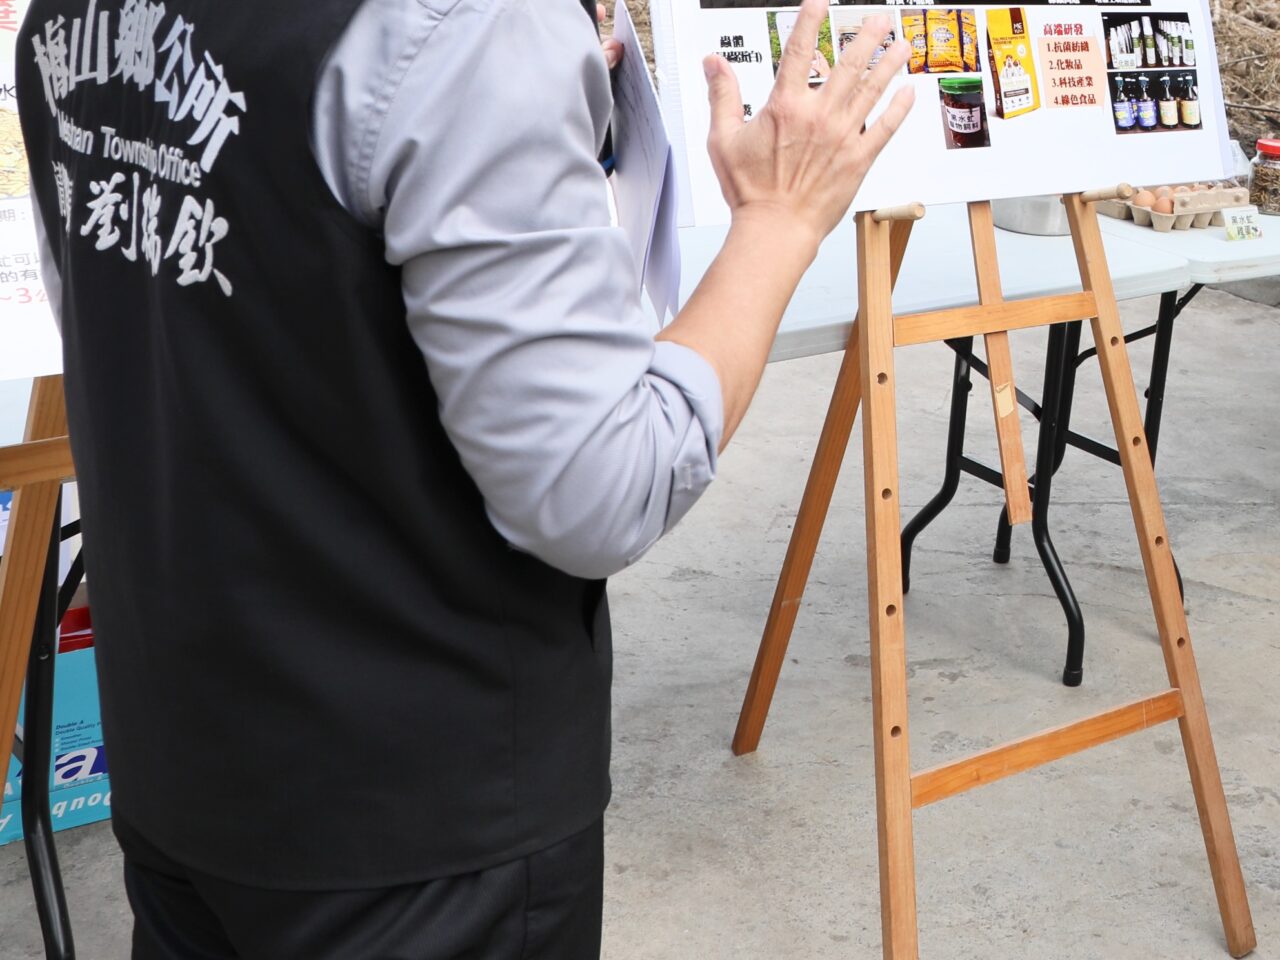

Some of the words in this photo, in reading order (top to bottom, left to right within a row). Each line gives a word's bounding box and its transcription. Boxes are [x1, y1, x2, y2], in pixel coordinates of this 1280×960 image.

[1043, 23, 1084, 36] 高端研發
[158, 143, 202, 188] Office
